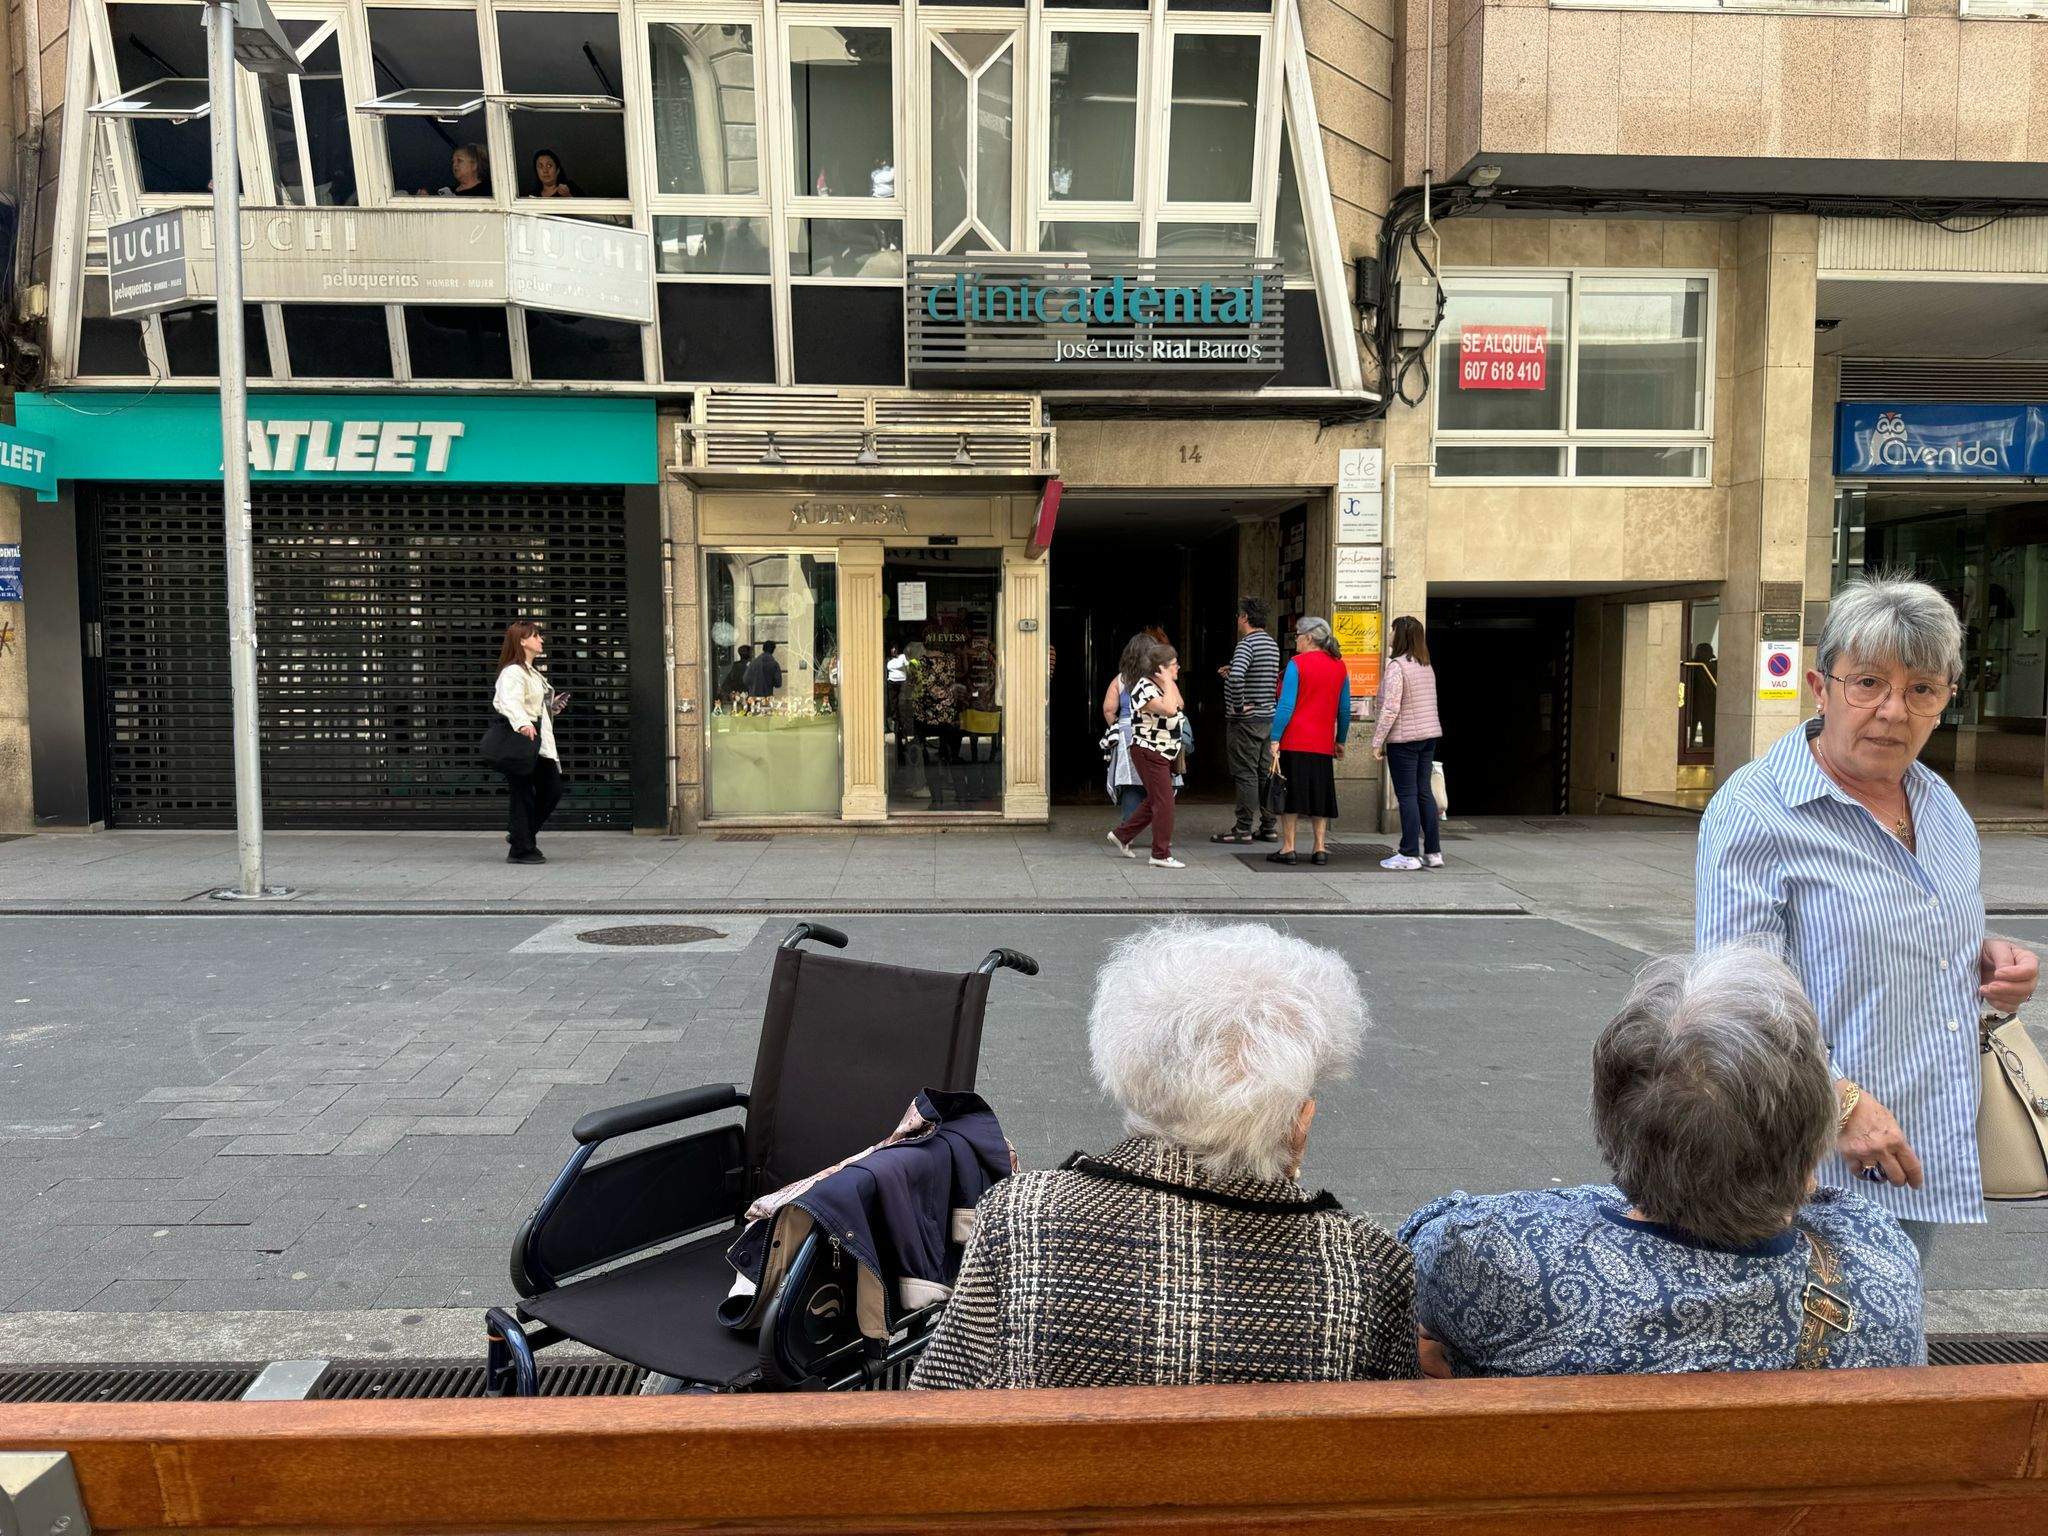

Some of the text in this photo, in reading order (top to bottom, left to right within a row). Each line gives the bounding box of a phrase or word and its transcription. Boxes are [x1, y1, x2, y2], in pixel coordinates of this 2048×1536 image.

[112, 220, 181, 266] LUCHI
[517, 224, 643, 272] LUCHI
[427, 279, 459, 288] HOMBRE
[468, 279, 494, 289] MUJER
[1055, 338, 1262, 362] José Luis Rial Barros
[1462, 333, 1544, 354] SE ALQUILA
[1464, 361, 1540, 382] 607 618 410
[0, 441, 46, 474] LEET
[1179, 444, 1203, 463] 14
[1883, 440, 1998, 466] avenida
[1771, 680, 1788, 688] VAO
